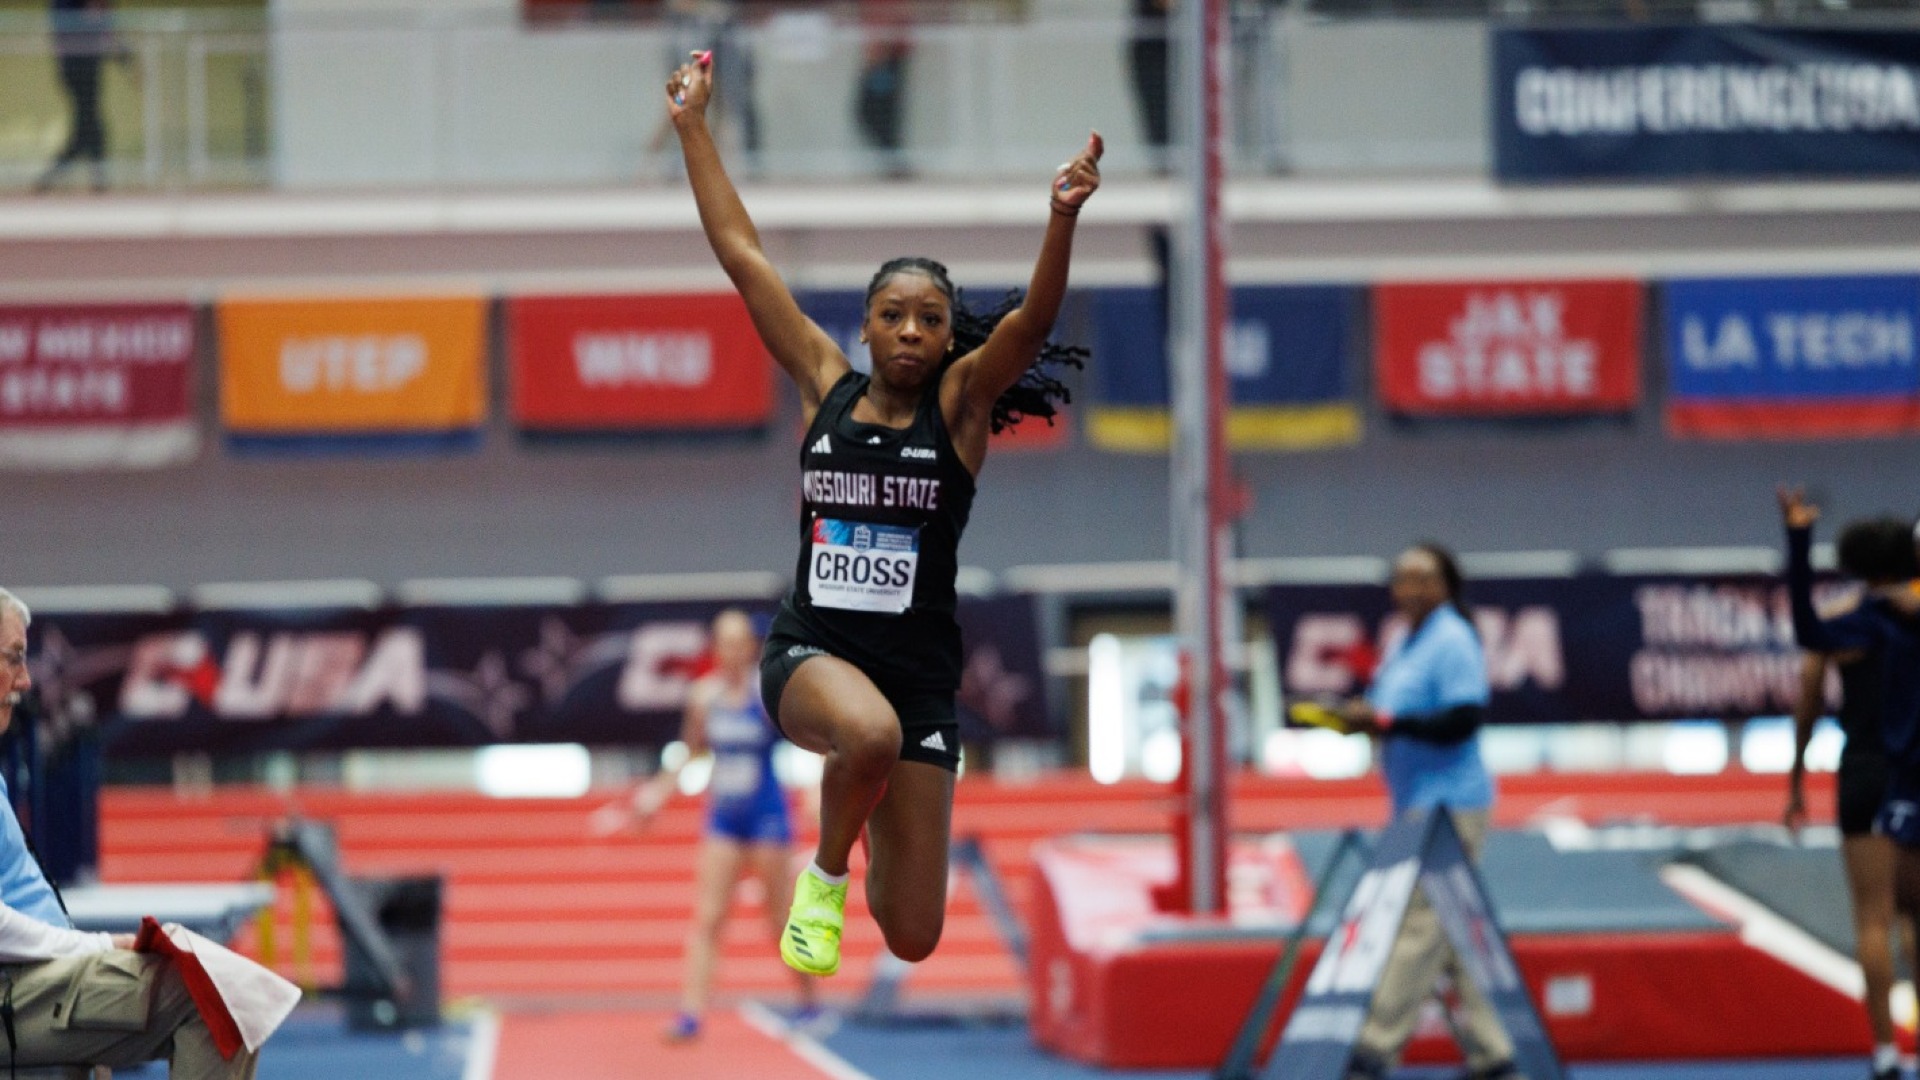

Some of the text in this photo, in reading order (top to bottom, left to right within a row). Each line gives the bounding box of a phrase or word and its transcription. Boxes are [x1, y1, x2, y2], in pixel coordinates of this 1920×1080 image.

[1451, 291, 1566, 340] JAX
[1682, 309, 1914, 372] LA TECH
[278, 333, 428, 394] UTEP
[572, 329, 713, 386] WKU
[1417, 338, 1597, 398] STATE
[804, 471, 940, 510] MISSOURI STATE
[816, 552, 910, 587] CROSS
